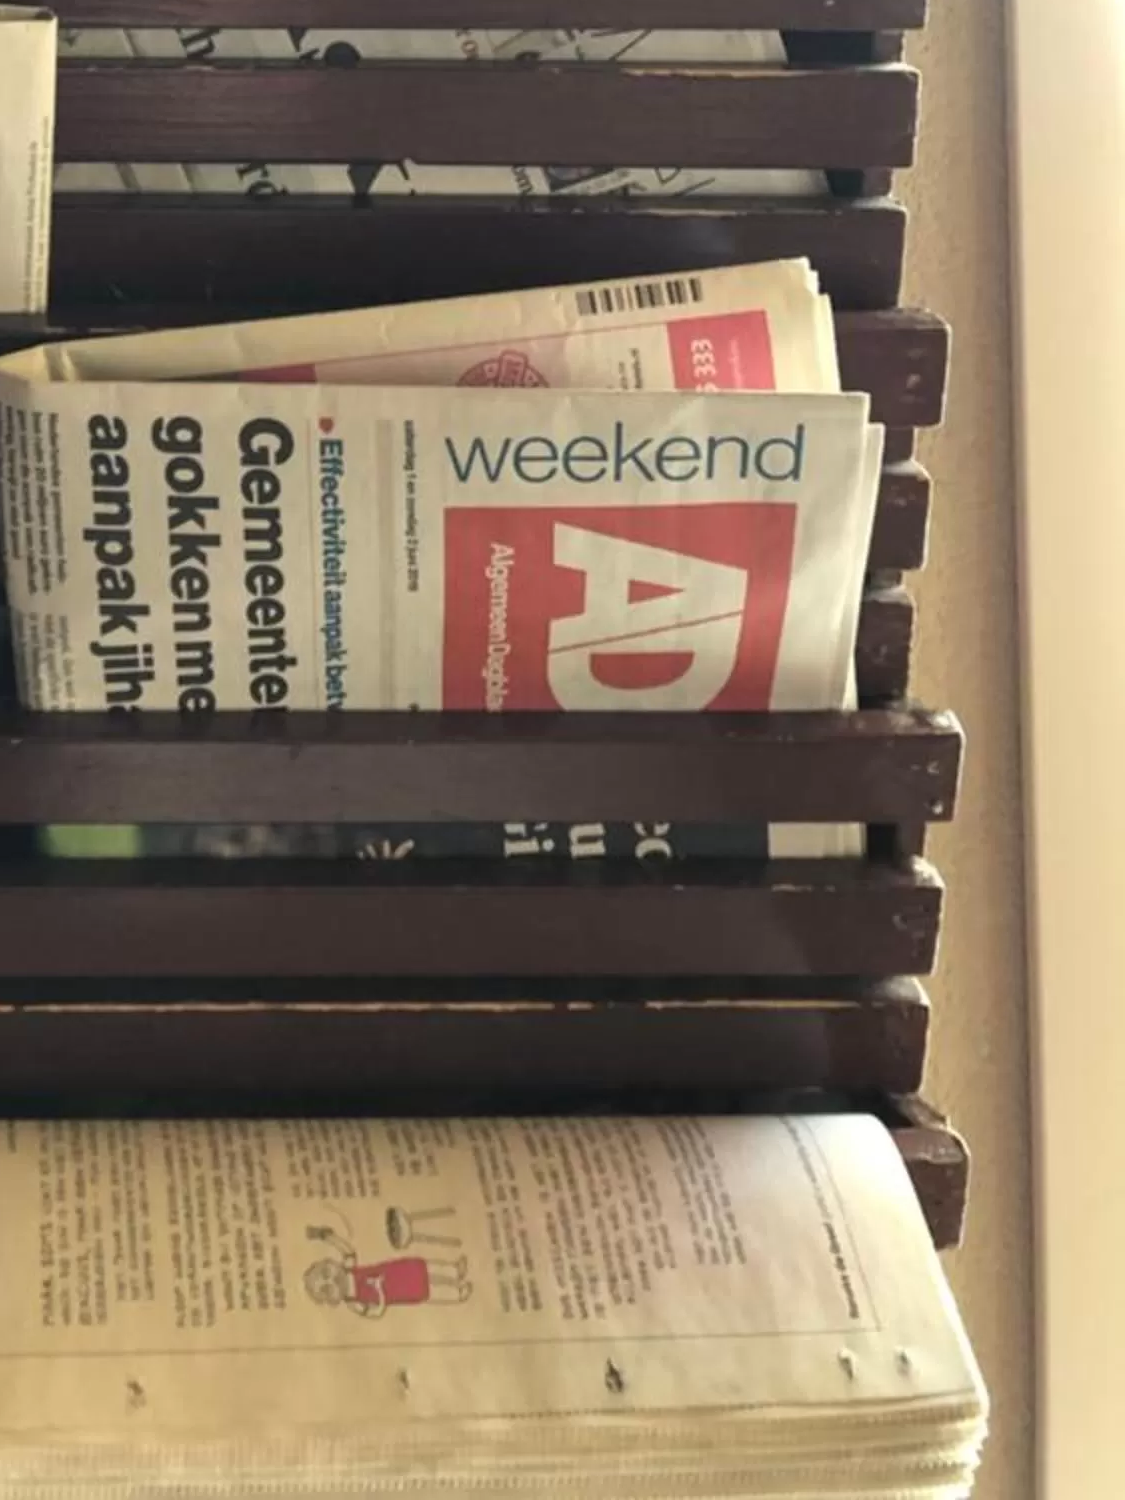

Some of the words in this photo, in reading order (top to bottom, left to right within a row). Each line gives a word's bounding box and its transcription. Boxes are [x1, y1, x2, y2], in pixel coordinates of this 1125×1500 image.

[81, 414, 150, 637] aanpak
[151, 416, 220, 632] gokken
[317, 438, 345, 586] Effectiviteit
[444, 421, 805, 483] weekend
[237, 418, 297, 711] Gemeente
[320, 590, 345, 660] aanpak
[485, 543, 514, 642] Algemeen
[547, 521, 747, 711] AD
[88, 640, 153, 711] jih
